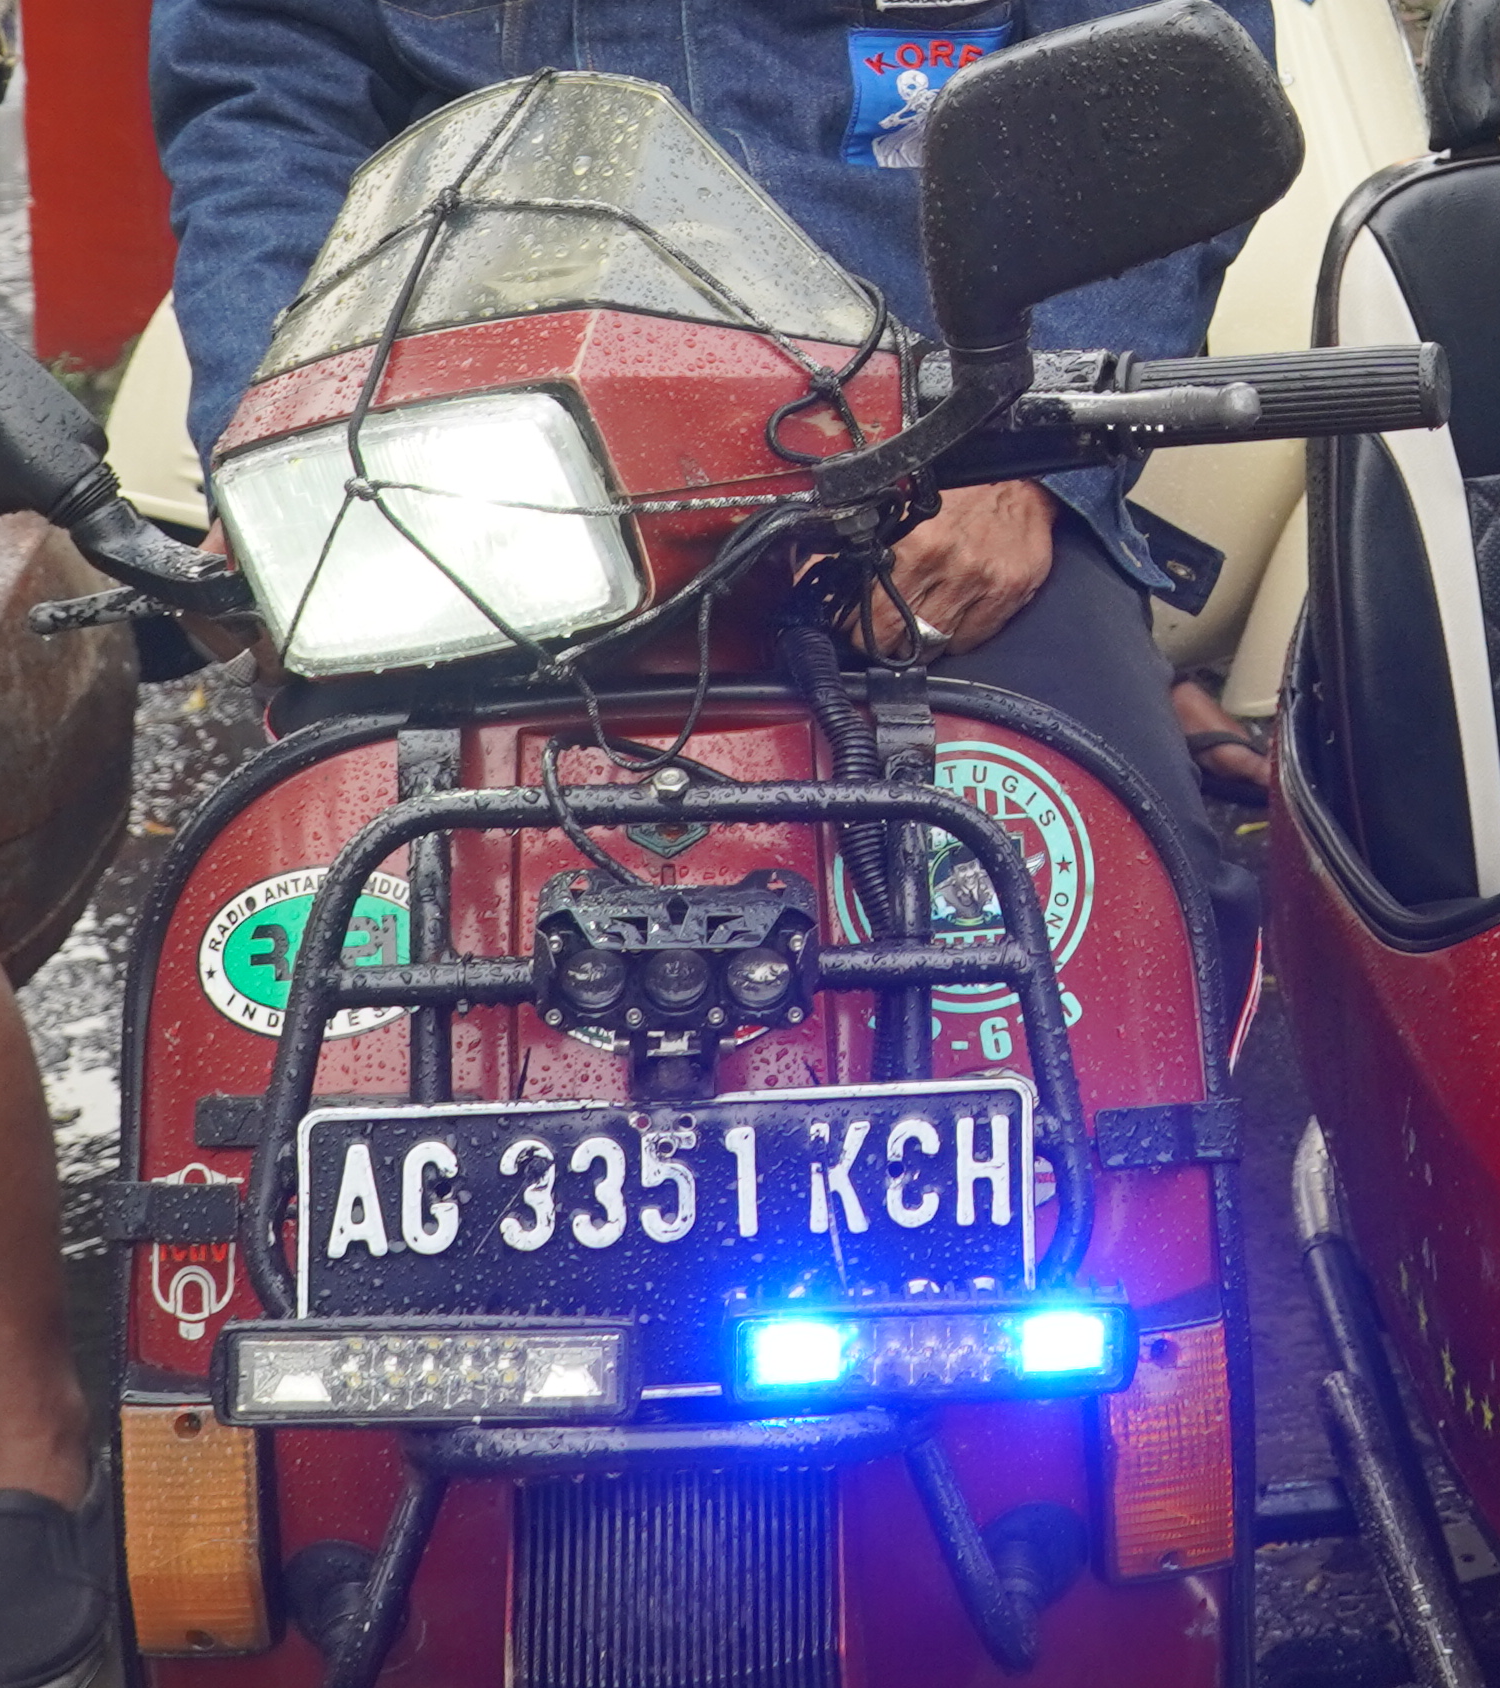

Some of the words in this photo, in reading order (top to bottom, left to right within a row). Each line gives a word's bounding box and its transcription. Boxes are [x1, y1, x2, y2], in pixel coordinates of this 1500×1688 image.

[942, 762, 1058, 828] TUGIS
[207, 894, 258, 953] RADIO
[327, 1139, 460, 1259] AG
[500, 1125, 760, 1254] 3351
[809, 1112, 1012, 1235] KCH
